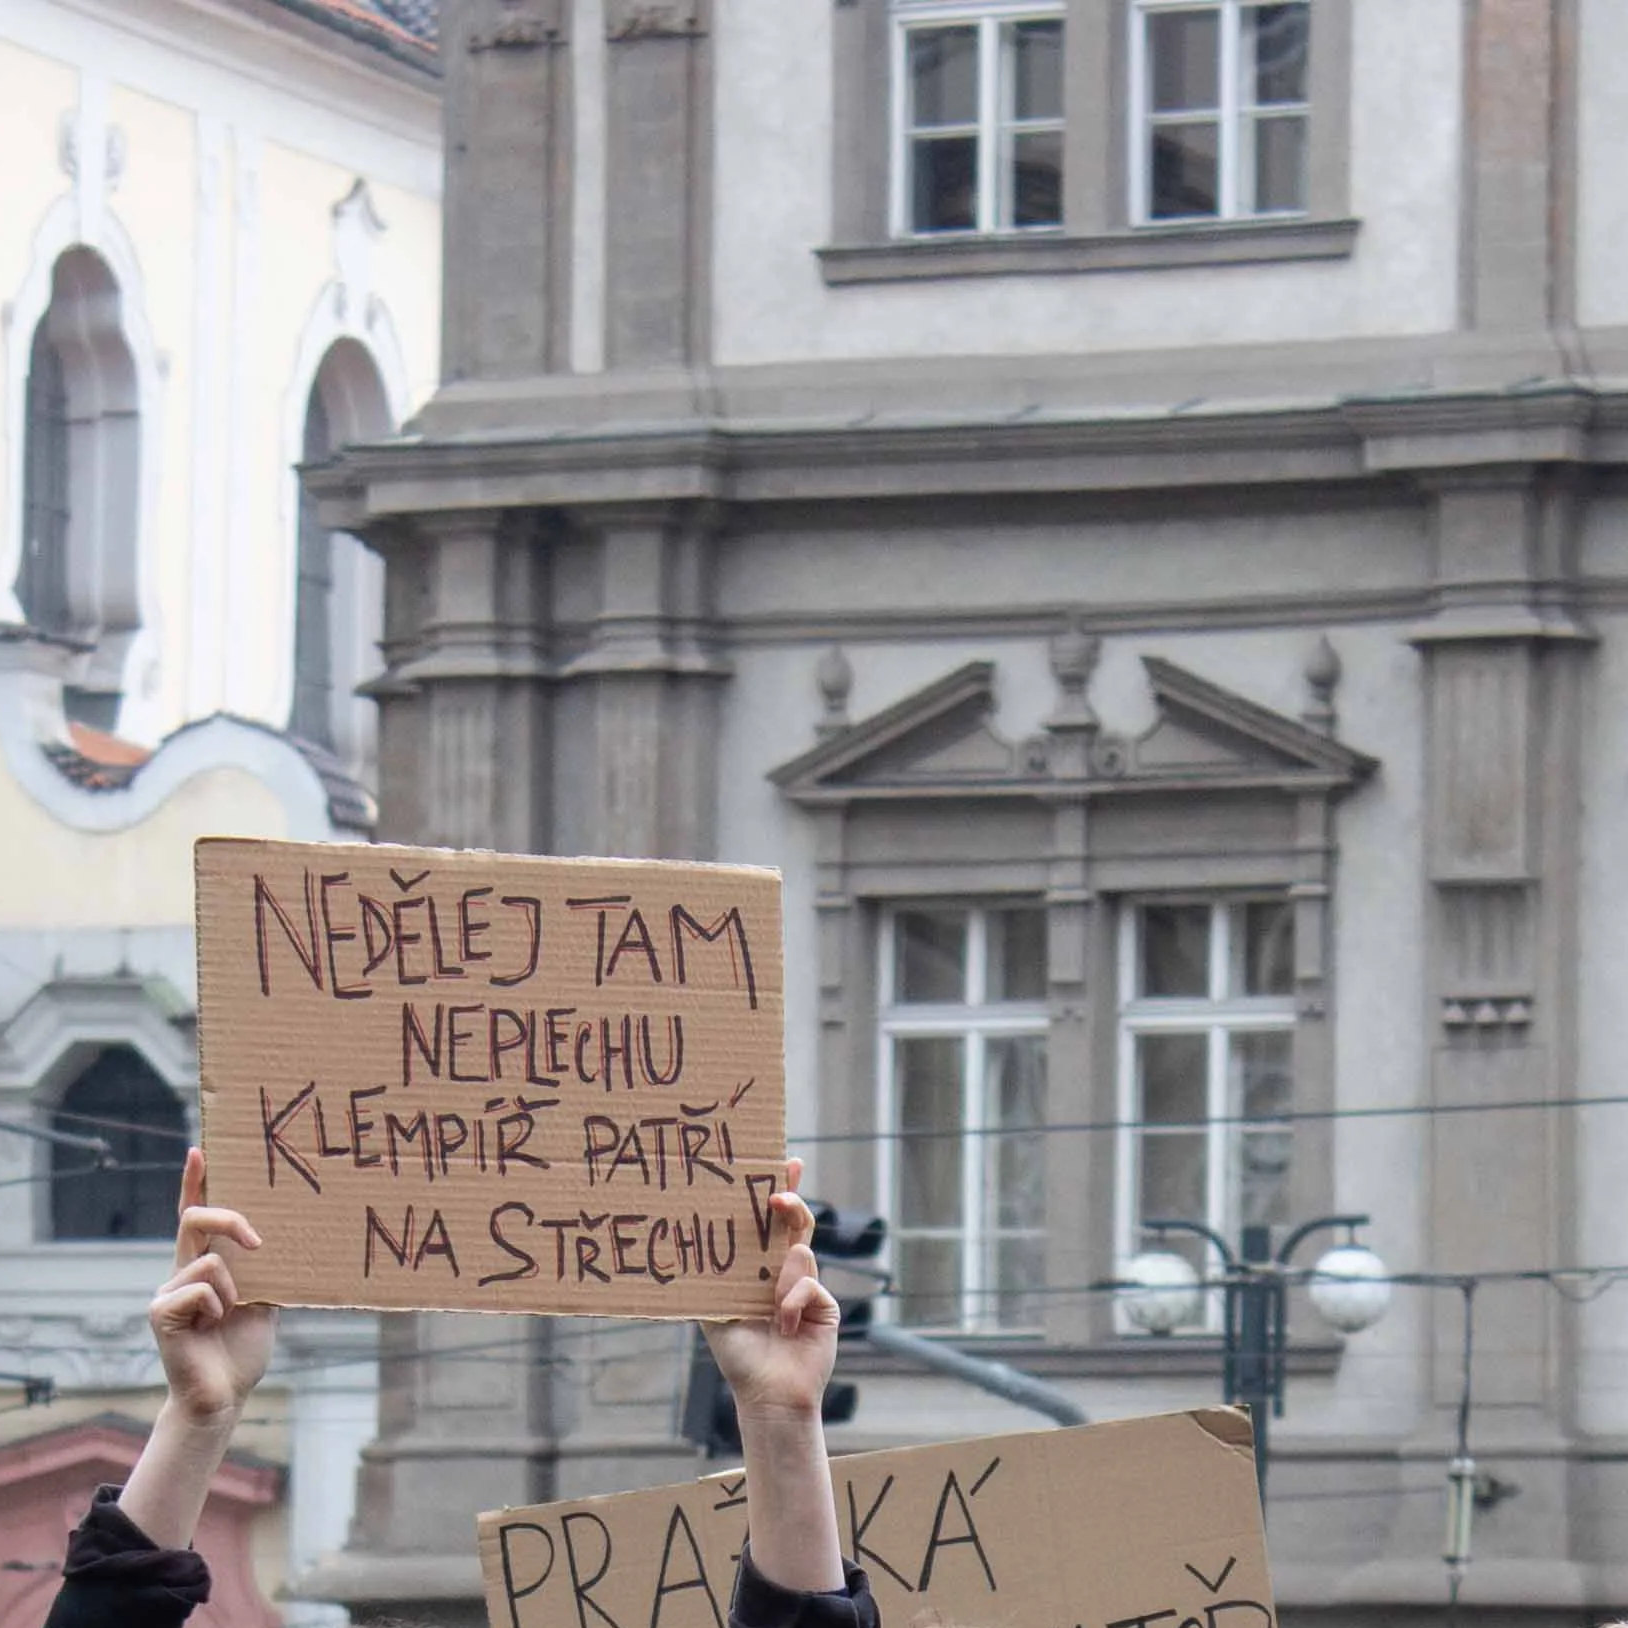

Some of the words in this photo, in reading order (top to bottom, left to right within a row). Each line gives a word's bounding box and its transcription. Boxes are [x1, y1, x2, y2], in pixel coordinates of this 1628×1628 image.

[253, 867, 542, 999] NEDĚLEJ
[565, 895, 758, 1010] TAM
[401, 1001, 684, 1091] NEPLECHU
[259, 1081, 562, 1194] KLEMPÍŘ
[583, 1077, 756, 1191] PATŘÍ
[363, 1204, 460, 1278] NA
